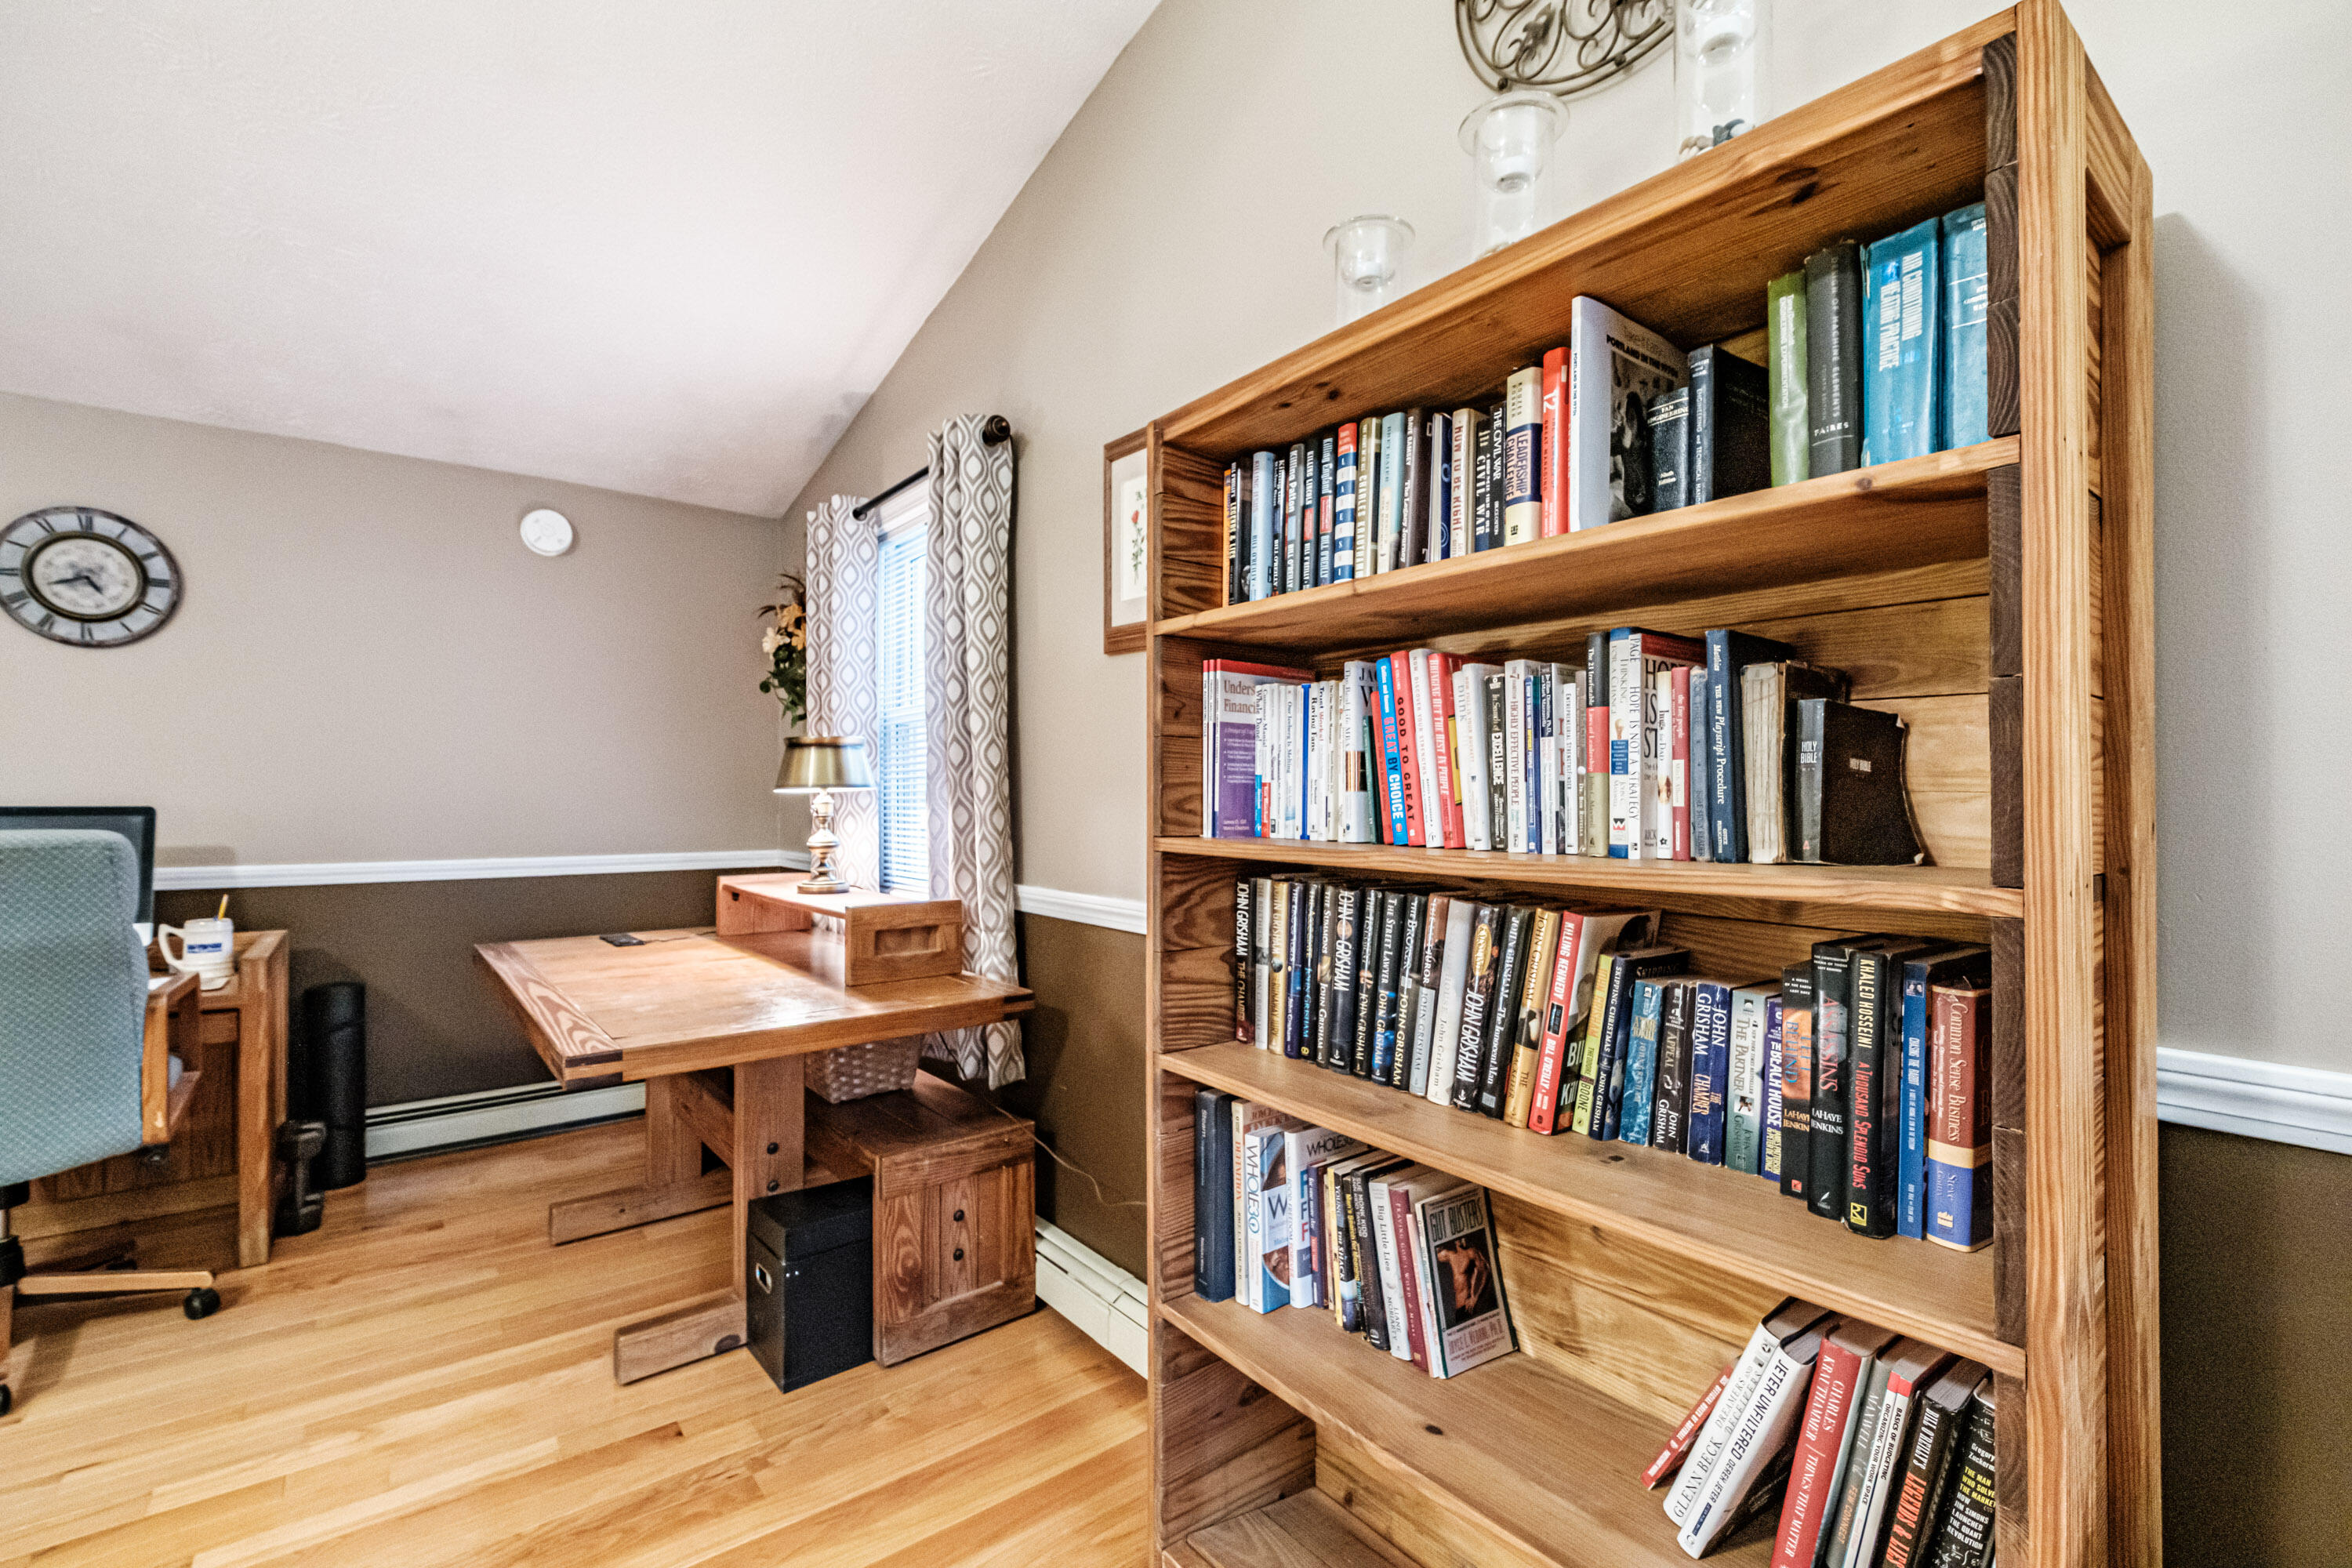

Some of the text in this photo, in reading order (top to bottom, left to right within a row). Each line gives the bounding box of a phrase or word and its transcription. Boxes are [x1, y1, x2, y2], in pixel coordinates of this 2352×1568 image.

[1880, 281, 1900, 324] HEATING
[1902, 252, 1922, 340] AIR CONDITIONING
[1506, 437, 1515, 499] CHALLENGE
[1516, 434, 1528, 493] LEADERSHIP
[1630, 638, 1639, 662] PAGE
[1430, 660, 1440, 697] BRINGING
[1433, 699, 1442, 714] OUT
[1630, 687, 1639, 713] HOPE
[1434, 717, 1443, 731] THE
[1630, 733, 1639, 754] NOT
[1713, 716, 1725, 755] Playscript
[1397, 697, 1414, 820] GOOD TO GREAT
[1492, 733, 1503, 785] EXCELLENCE
[1801, 752, 1817, 764] BIBLE
[1802, 742, 1817, 752] HOLY
[1384, 717, 1403, 818] GREAT BY CHOICE
[1439, 767, 1448, 794] PEOPLE
[1717, 758, 1726, 804] Procedure
[1511, 776, 1519, 805] PEOPLE
[1236, 882, 1248, 956] JOHN GRISHAM
[1385, 920, 1395, 948] STREET
[1334, 891, 1354, 990] JOHN GRISHAM
[1381, 951, 1392, 983] LAWYER
[1554, 922, 1574, 1000] KILLING KENNEDY
[1604, 967, 1621, 1052] SKIPPING CHRISTMAS
[1694, 993, 1711, 1054] GRISHAM
[1857, 960, 1875, 1048] KHALED HOSSEINI
[1374, 990, 1388, 1064] JOHN GRISHAM
[1393, 993, 1408, 1084] JOHN GRISHAM
[1457, 989, 1483, 1082] JOHN GRISHAM
[1490, 1026, 1504, 1065] Innocent
[1545, 1039, 1555, 1054] BILL
[1711, 1007, 1726, 1047] JOHN
[1820, 996, 1839, 1091] ASSASSINS
[1585, 1047, 1594, 1075] THEODORE
[1664, 1033, 1676, 1067] APPEAL
[1734, 1020, 1749, 1091] THE PARTNER
[1784, 1021, 1798, 1083] BEHIND
[1488, 1066, 1497, 1083] Man
[1767, 1051, 1781, 1126] BEACH HOUSE
[1947, 1002, 1968, 1142] Common Sense Business
[1578, 1083, 1593, 1112] BOONE
[1592, 1072, 1606, 1131] JOHN GRISHAM
[1693, 1074, 1711, 1115] CHAMBER
[1711, 1092, 1721, 1105] THE
[1854, 1070, 1872, 1116] THOUSAND
[1657, 1099, 1668, 1143] GRISHAM
[1668, 1111, 1679, 1138] JOHN
[1811, 1120, 1842, 1134] JENKINS
[1812, 1109, 1842, 1123] LAHAYE
[1853, 1121, 1871, 1163] SPLENDID
[1853, 1164, 1871, 1189] SUNS
[1377, 1205, 1392, 1271] Big Little Lies
[1430, 1204, 1485, 1243] GUT BUSTERS
[1730, 1359, 1789, 1461] JETER UNFILTERED
[1806, 1356, 1835, 1441] KRAUTHAMMER
[1822, 1381, 1845, 1432] CHARLES
[1926, 1408, 1939, 1425] BILL
[1861, 1404, 1891, 1505] ORGANIZING YOUR WORK SPACE
[1881, 1408, 1902, 1480] BASICS OF BUDGETING
[1972, 1443, 1995, 1461] Gregory
[1708, 1458, 1737, 1503] DEREK JETER
[1960, 1483, 1973, 1497] THE
[1962, 1475, 1995, 1498] WHO SOLVE
[1965, 1466, 1991, 1486] THE MAN
[1784, 1456, 1818, 1558] THINGS THAT MATTER
[1899, 1472, 1926, 1526] LEGENDS
[1954, 1501, 1989, 1524] JIM SIMONS
[1957, 1492, 1970, 1505] HOW
[1893, 1525, 1912, 1537] &
[1947, 1525, 1984, 1550] REVOLUTION
[1949, 1516, 1983, 1541] THE QUANT
[1952, 1510, 1984, 1530] LAUNCHED
